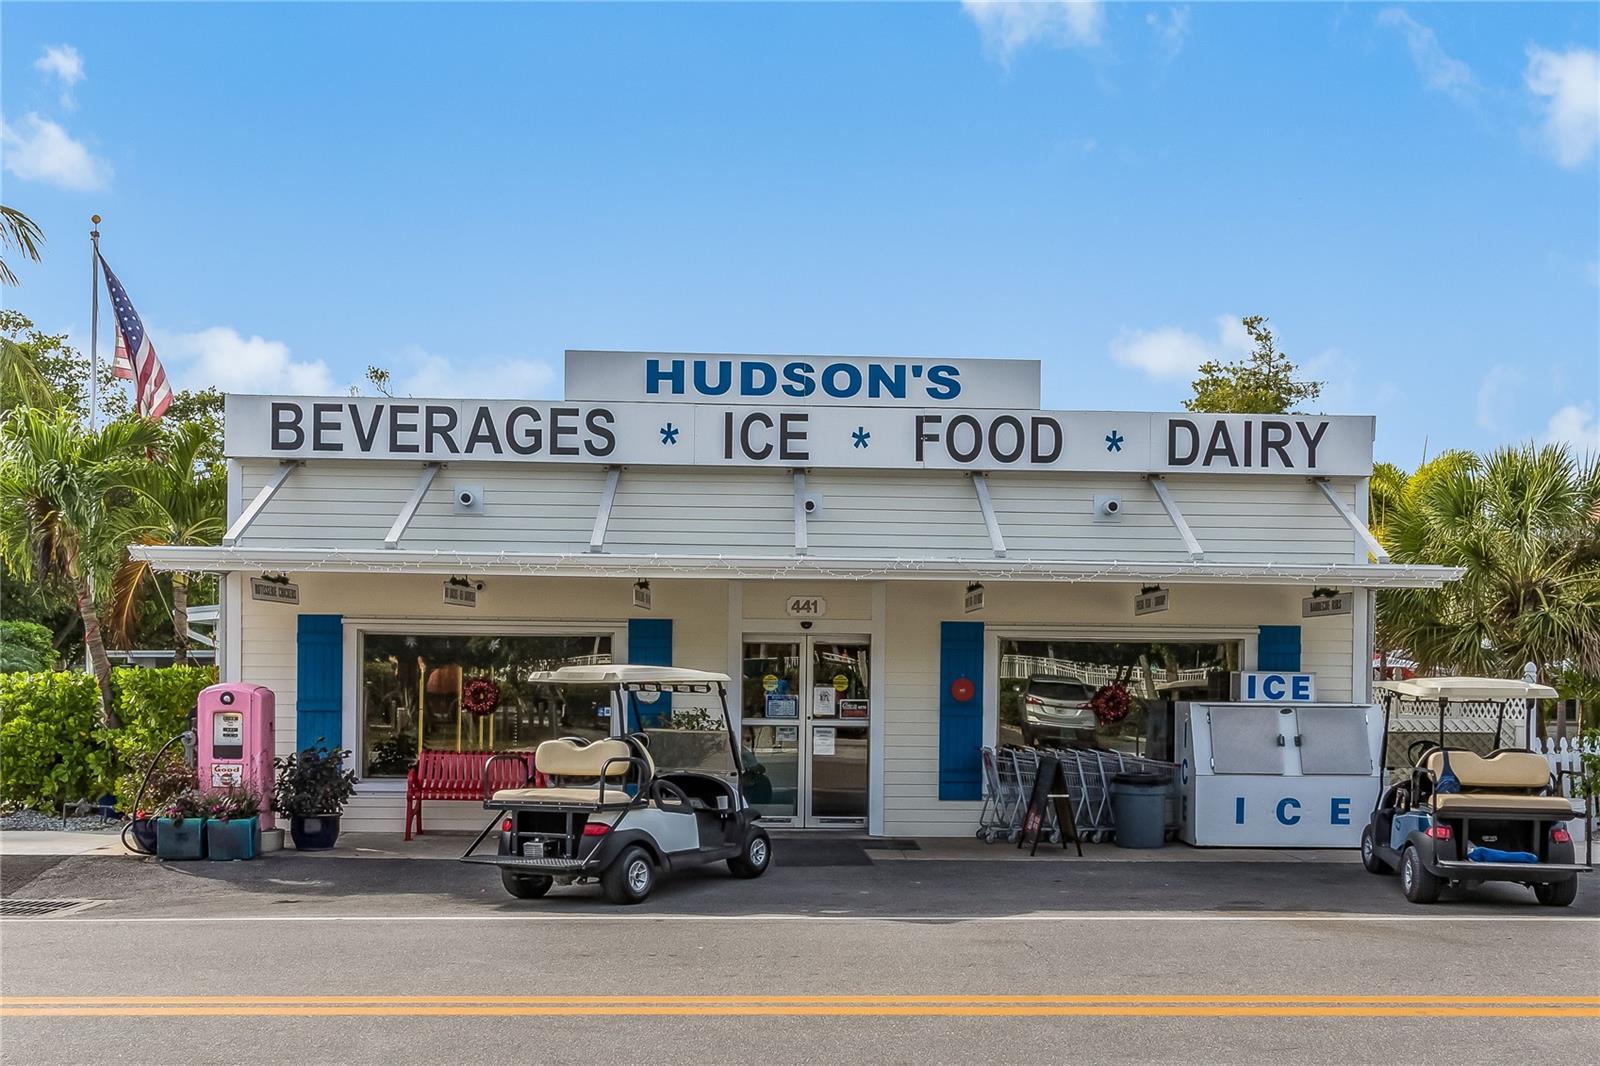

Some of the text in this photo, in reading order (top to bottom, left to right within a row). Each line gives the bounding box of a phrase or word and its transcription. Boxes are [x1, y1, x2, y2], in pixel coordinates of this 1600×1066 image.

[645, 359, 961, 400] HUDSON'S
[271, 402, 1329, 469] BEVERAGES ICE FOOD DAIRY
[791, 599, 818, 614] 441
[1248, 675, 1310, 700] ICE
[214, 764, 240, 773] Good
[1235, 797, 1351, 826] ICE
